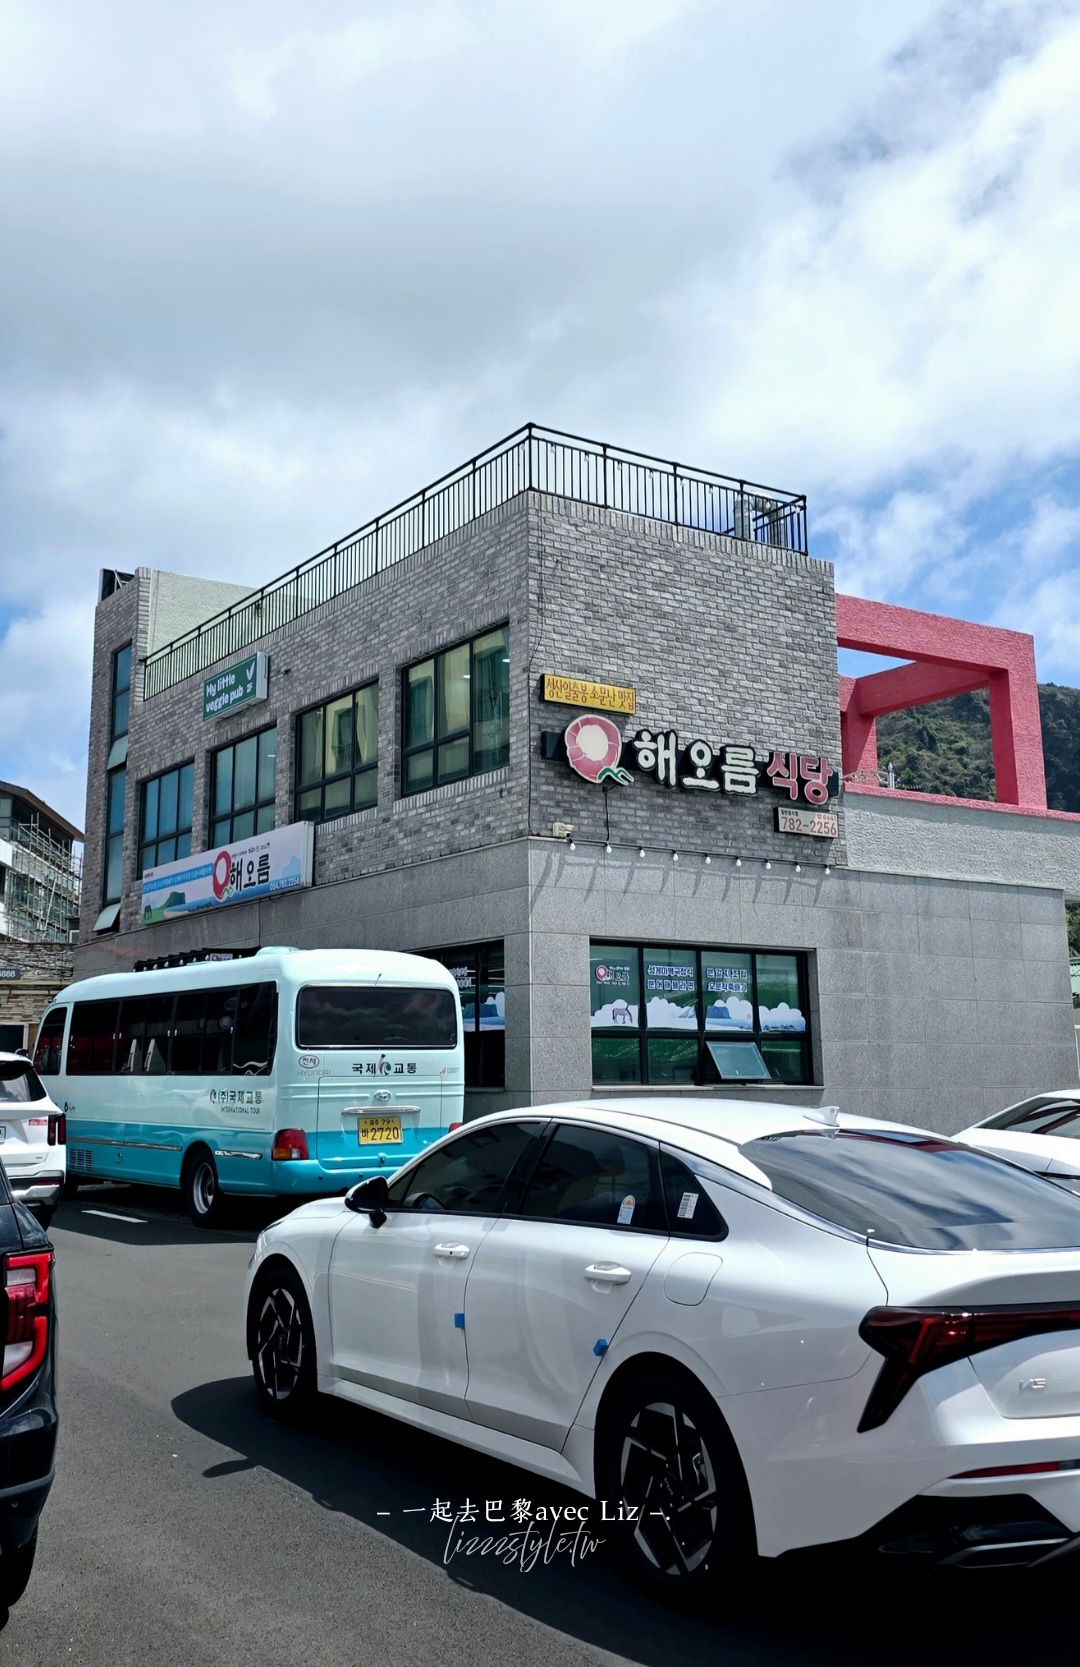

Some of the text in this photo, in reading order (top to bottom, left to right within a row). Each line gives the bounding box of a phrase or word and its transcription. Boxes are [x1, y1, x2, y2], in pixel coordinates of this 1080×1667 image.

[206, 673, 235, 697] My little
[546, 678, 634, 711] 성산일출봉 소문난 맛집
[206, 684, 244, 713] veggie pub
[632, 729, 834, 805] 해오름 식당
[782, 816, 837, 836] 782-2256
[230, 853, 271, 892] 해오름
[352, 1062, 418, 1075] 국제 교통
[217, 1090, 263, 1105] (주)국제교통
[370, 1126, 400, 1141] 2720
